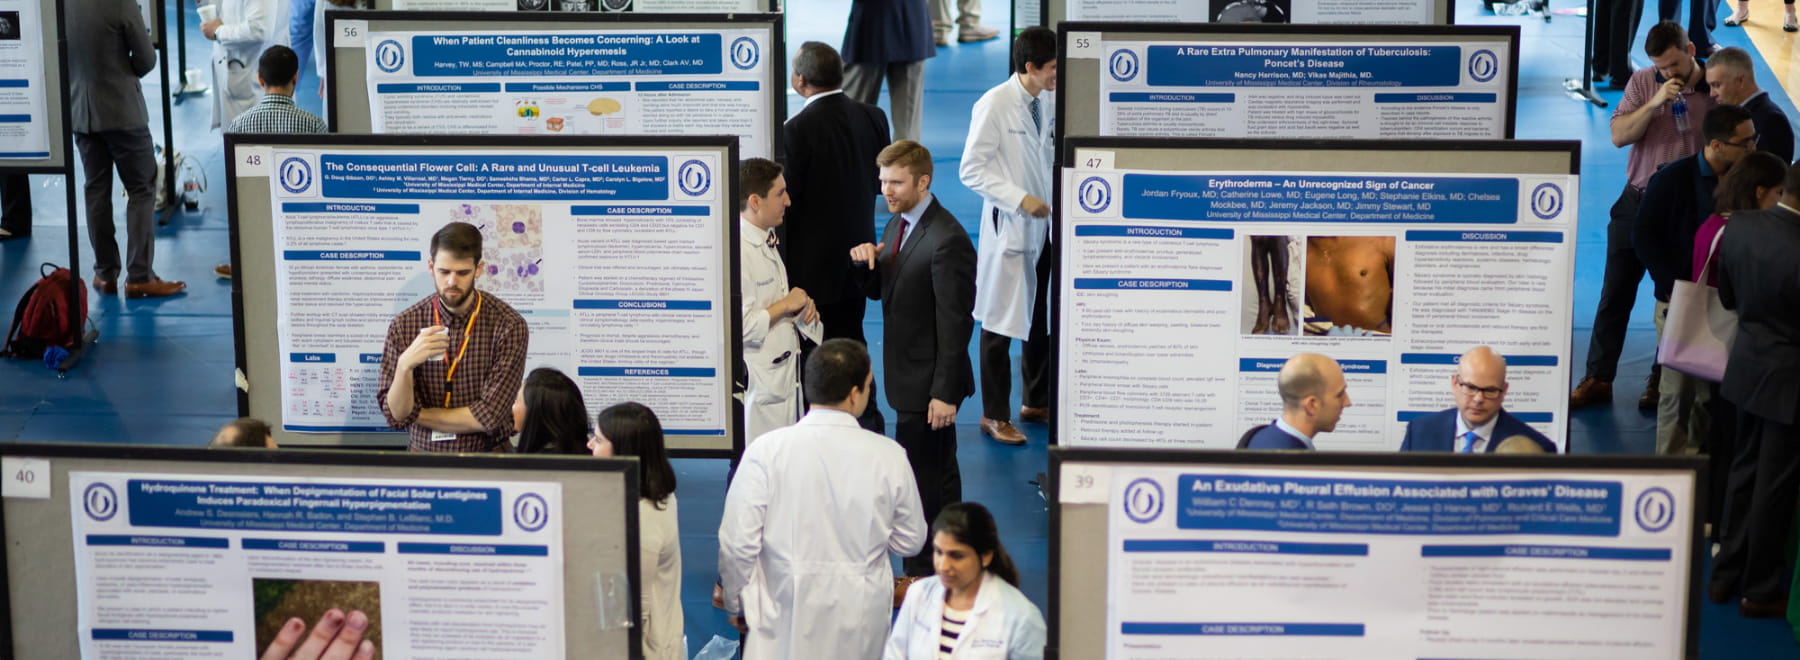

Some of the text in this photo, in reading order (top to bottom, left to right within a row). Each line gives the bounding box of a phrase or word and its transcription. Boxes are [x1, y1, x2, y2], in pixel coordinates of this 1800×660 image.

[344, 27, 358, 37] 56
[433, 34, 700, 46] When Patient Cleanliness Becomes Concerning: A Look at
[1076, 39, 1090, 48] 55
[507, 46, 627, 58] Cannabinoid Hyperemesis
[1177, 48, 1431, 58] A Rare Extra Pulmonary Manifestation of Tuberculosis:
[486, 60, 514, 69] Campbell
[1264, 59, 1344, 68] Poncet's Disease
[1234, 72, 1257, 80] Nancy
[246, 155, 261, 166] 48
[1086, 158, 1102, 168] 47
[325, 162, 660, 174] The Consequential Flower Cell: A Rare and Unusual T-cell Leukemia
[1208, 179, 1434, 191] Erythroderma An Unrecognized Sign of Cancer
[1141, 189, 1168, 197] Jordan
[1221, 190, 1258, 198] Catherine
[1305, 191, 1335, 201] Eugene
[1380, 192, 1419, 202] Stephanie
[1468, 192, 1500, 200] Chelsea
[1269, 202, 1298, 211] Jeremy
[1355, 202, 1381, 212] Jimmy
[1206, 211, 1241, 220] University
[1252, 211, 1291, 220] Mississippi
[1350, 212, 1392, 221] Department
[1127, 228, 1182, 236] INTRODUCTION
[16, 470, 34, 483] 40
[1074, 475, 1094, 488] 39
[141, 484, 488, 502] Hydroquinone Treatment: When Depigmentation of Facial Solar Lentigines
[1192, 481, 1212, 492] An
[1215, 482, 1281, 494] Exudative
[1284, 484, 1331, 495] Pleural
[1334, 485, 1390, 496] Effusion
[1393, 486, 1468, 498] Associated
[1470, 486, 1498, 498] with
[1554, 486, 1608, 498] Disease
[197, 496, 431, 512] Induces Paradoxical Fingernail Hyperpigmentation
[149, 632, 197, 640] DESCRIPTION
